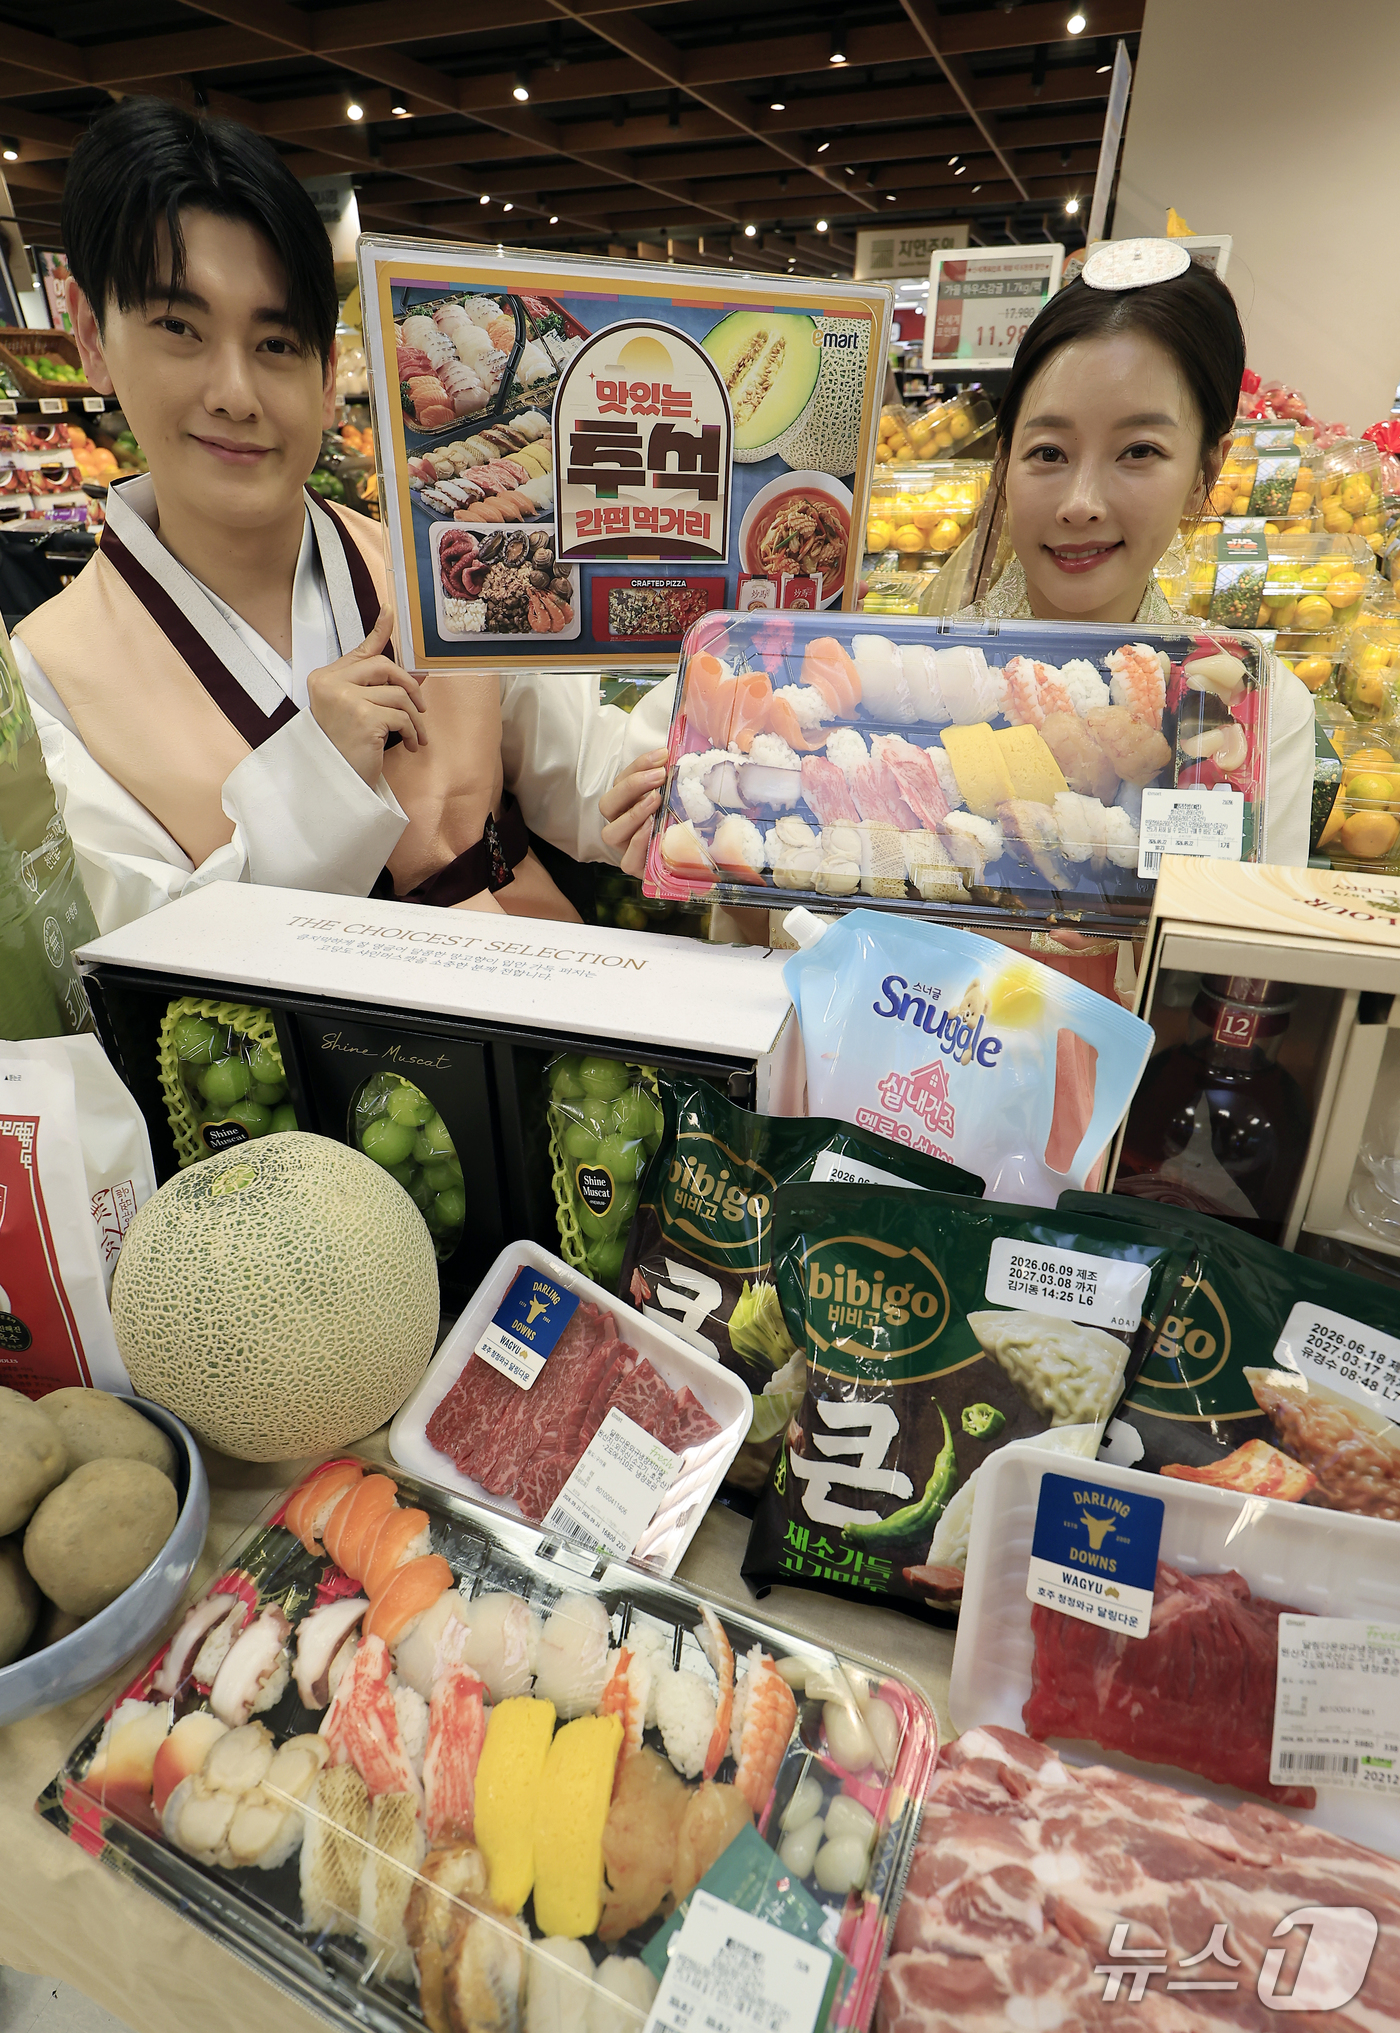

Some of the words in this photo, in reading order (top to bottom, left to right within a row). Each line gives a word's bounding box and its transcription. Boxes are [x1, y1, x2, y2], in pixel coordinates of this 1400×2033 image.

[812, 328, 860, 350] emart
[977, 325, 1030, 347] 11,98
[595, 379, 693, 418] 맛있는
[566, 418, 721, 502] 추석
[575, 506, 631, 538] 간편
[633, 506, 711, 540] 먹거리
[631, 578, 666, 588] CRAFTED
[667, 578, 687, 588] PIZZA
[286, 915, 341, 933] THE
[343, 923, 482, 949] CHOICEST
[484, 940, 650, 971] SELECTION
[912, 981, 942, 1000] 스너글
[872, 974, 1003, 1068] Snuggle
[1222, 1015, 1250, 1037] 12
[320, 1031, 379, 1057] Shine
[381, 1044, 453, 1071] Muscat
[879, 1073, 955, 1138] 실내건조
[209, 1128, 239, 1140] Shine
[209, 1133, 248, 1148] Muscat
[582, 1185, 611, 1198] Muscat
[583, 1174, 607, 1187] Shine
[673, 1188, 719, 1222] 비비고
[1009, 1267, 1072, 1289] 2027.03.08
[1075, 1280, 1097, 1295] 까지
[1010, 1255, 1074, 1277] 2026.06.09
[1076, 1268, 1098, 1282] 제조
[532, 1280, 561, 1306] DARLING
[809, 1262, 939, 1327] bibigo
[1042, 1287, 1074, 1302] 14:25
[1078, 1294, 1094, 1306] L6
[512, 1318, 537, 1342] DOWNS
[827, 1303, 881, 1330] 비비고
[1110, 1316, 1136, 1327] ADA1
[499, 1334, 521, 1357] WAGYU
[1306, 1334, 1381, 1375] 2027.03.17
[1311, 1322, 1387, 1365] 2026.06.18
[481, 1343, 492, 1354] 호주
[508, 1360, 531, 1383] 달링다운
[1301, 1346, 1338, 1370] 유경수
[1340, 1366, 1379, 1391] 08:48
[649, 1444, 674, 1471] Fresh
[789, 1399, 914, 1527] 큰
[1072, 1490, 1131, 1519] DARLING
[617, 1540, 627, 1552] 220
[783, 1519, 893, 1580] 채소가득
[1069, 1546, 1118, 1573] DOWNS
[1061, 1571, 1104, 1596] WAGYU
[1036, 1586, 1056, 1600] 호주
[1057, 1591, 1095, 1614] 청정와규
[1096, 1604, 1139, 1629] 달링다운
